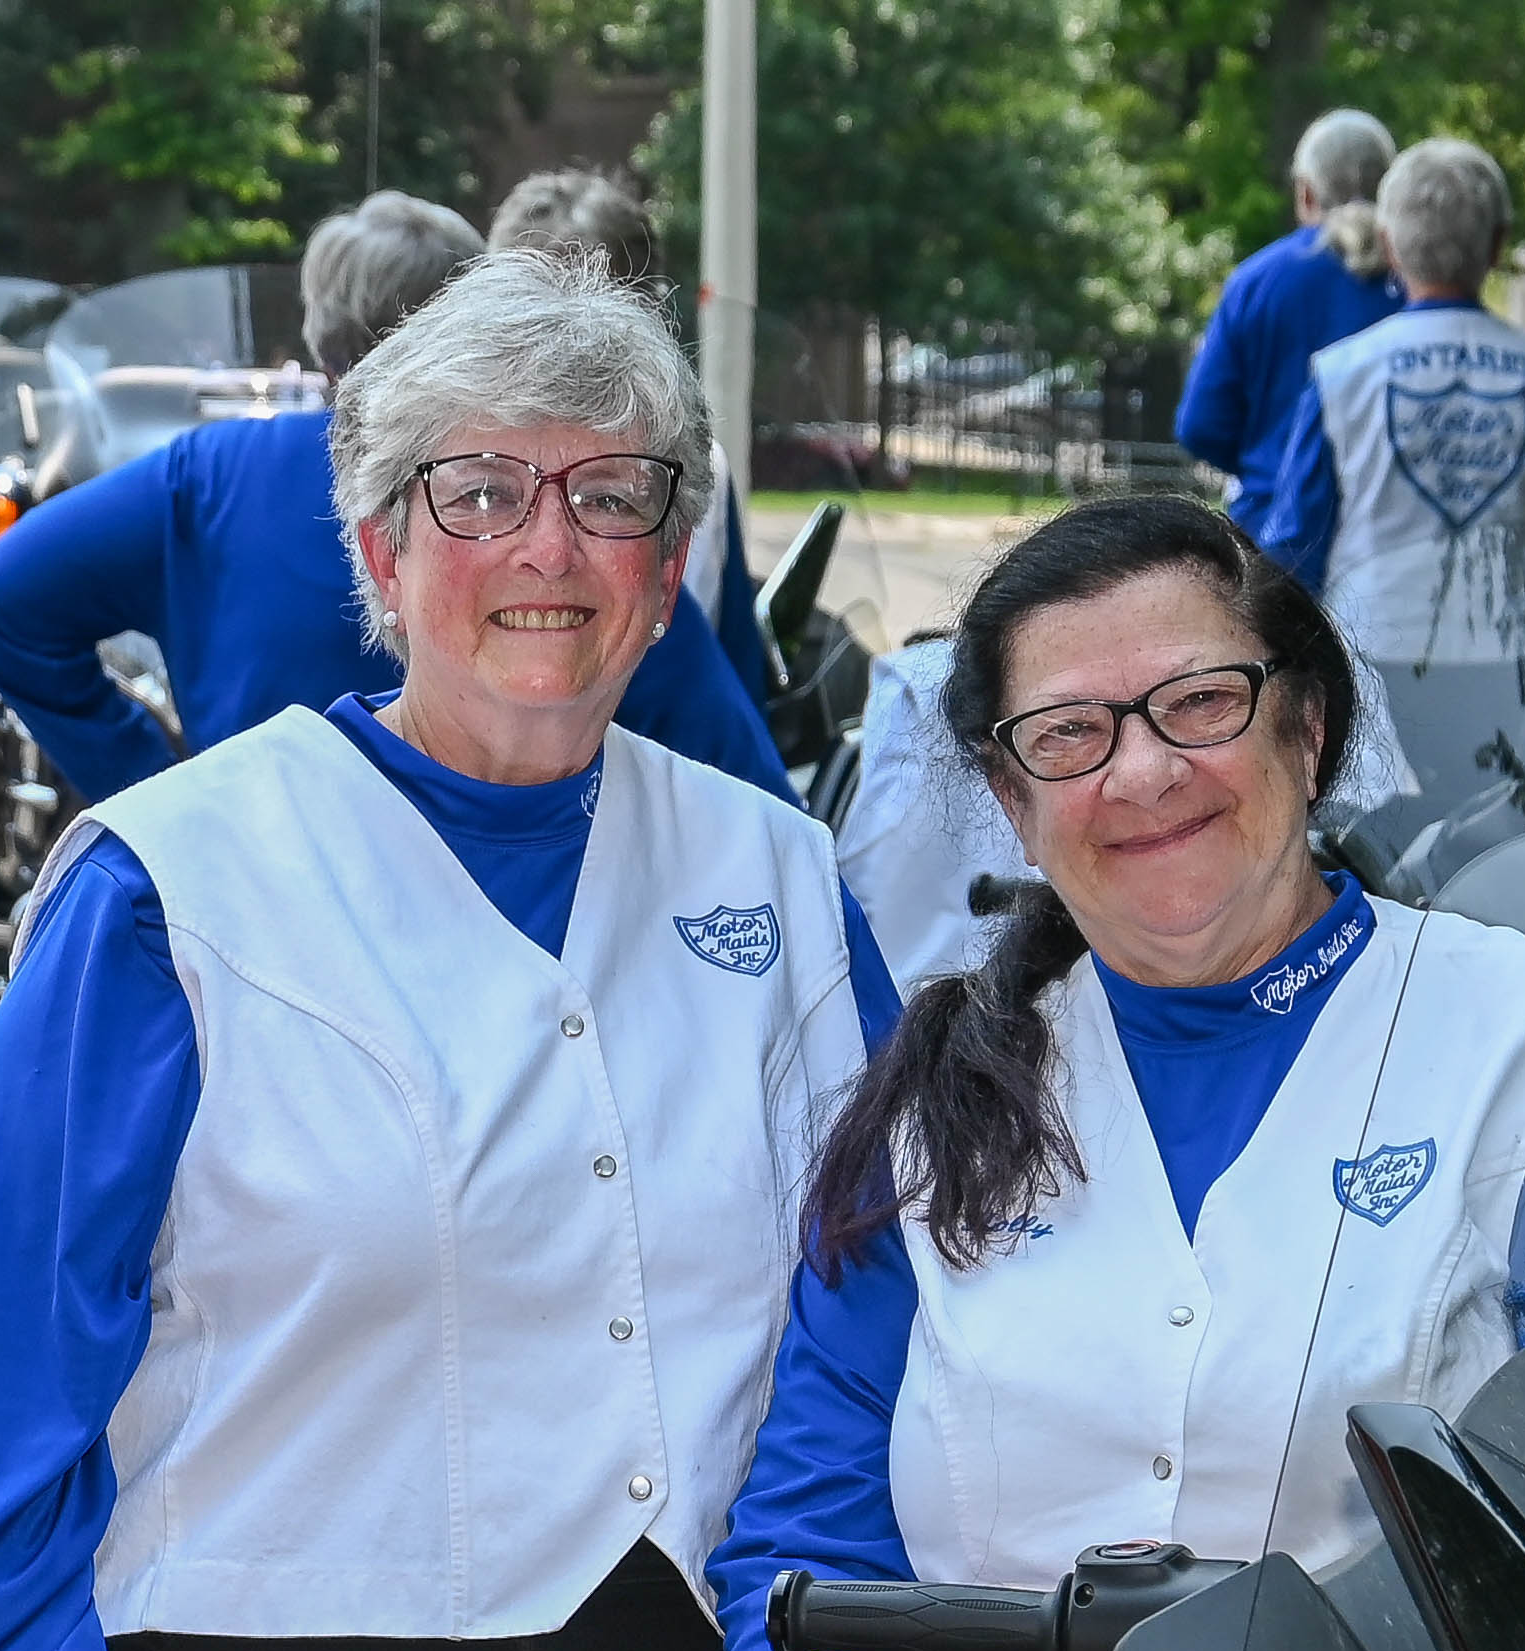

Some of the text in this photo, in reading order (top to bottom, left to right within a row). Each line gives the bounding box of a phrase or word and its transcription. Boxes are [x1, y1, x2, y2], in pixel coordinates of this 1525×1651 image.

[694, 915, 768, 943] Motor
[709, 931, 770, 954] Maids
[1263, 962, 1319, 1009] Motor
[1319, 932, 1348, 975] Maids
[1343, 1153, 1423, 1187] Motor
[1354, 1170, 1417, 1200] Maids
